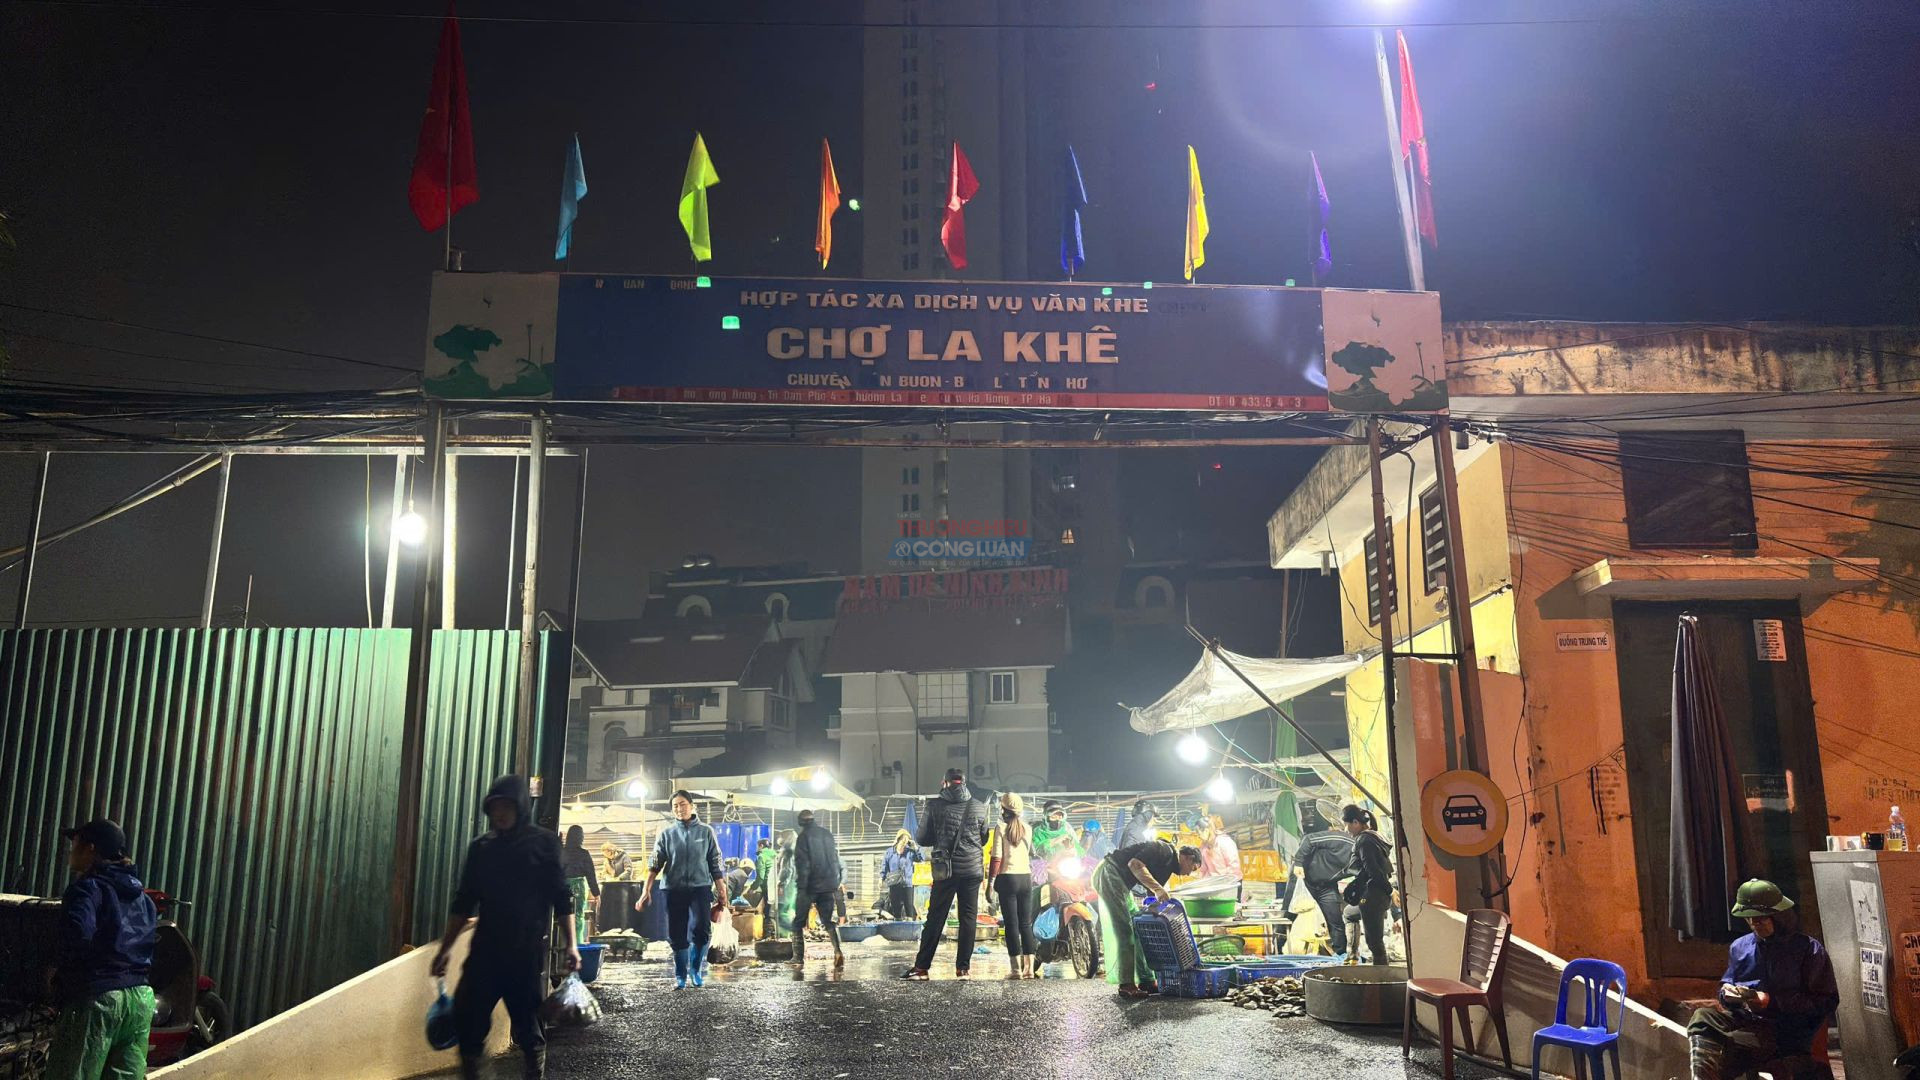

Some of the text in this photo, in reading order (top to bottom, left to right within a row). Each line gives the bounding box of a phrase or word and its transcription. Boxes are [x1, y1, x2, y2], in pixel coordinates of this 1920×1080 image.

[740, 290, 798, 308] HỢP
[807, 288, 858, 308] TÁC
[866, 293, 902, 309] XA
[914, 294, 977, 313] DỊCH
[987, 296, 1023, 315] VỤ
[1032, 293, 1086, 313] VĂN
[1094, 297, 1149, 313] KHE
[766, 324, 1119, 365] CHỢ LA KHÊ
[1578, 637, 1596, 646] TRUNG
